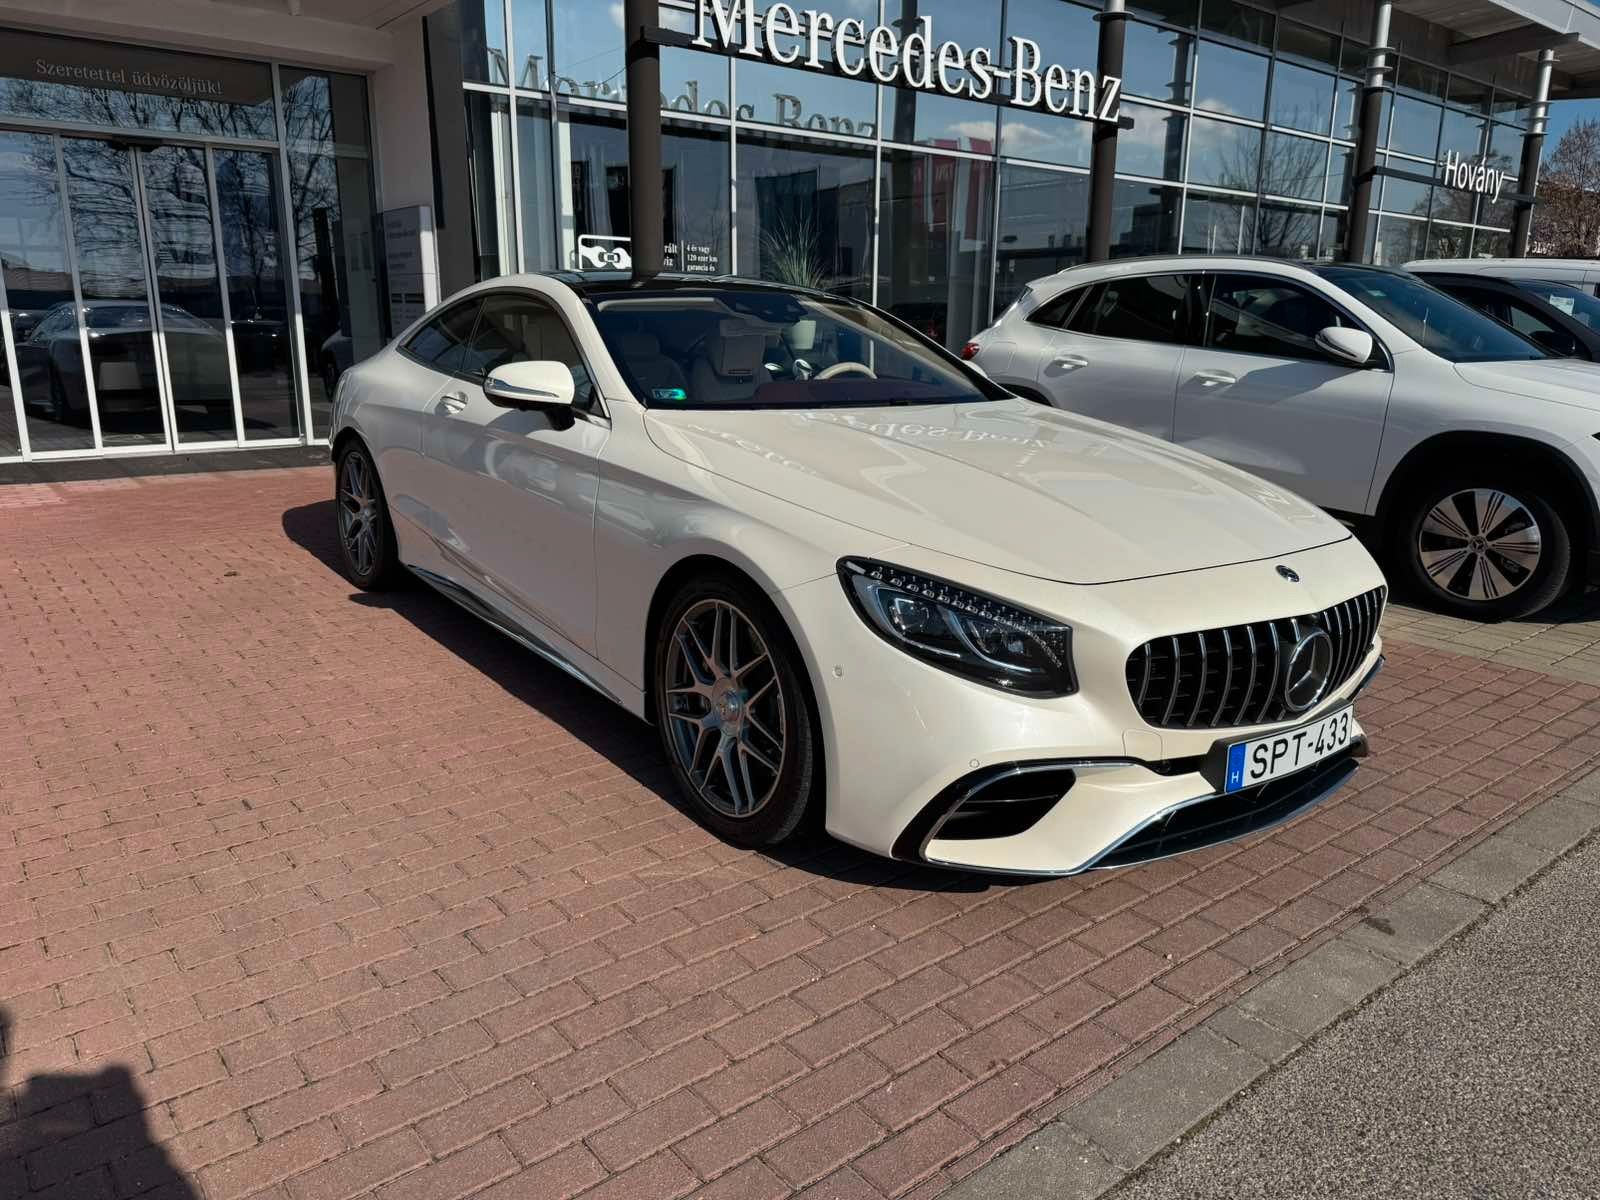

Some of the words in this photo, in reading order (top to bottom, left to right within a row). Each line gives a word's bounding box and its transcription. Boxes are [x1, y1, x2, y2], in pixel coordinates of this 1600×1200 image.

[35, 57, 126, 84] Szeretettel
[692, 0, 1121, 123] Mercedes-Benz
[1444, 149, 1505, 204] Hovány
[1250, 712, 1349, 779] SPT-433
[1231, 770, 1239, 784] H
